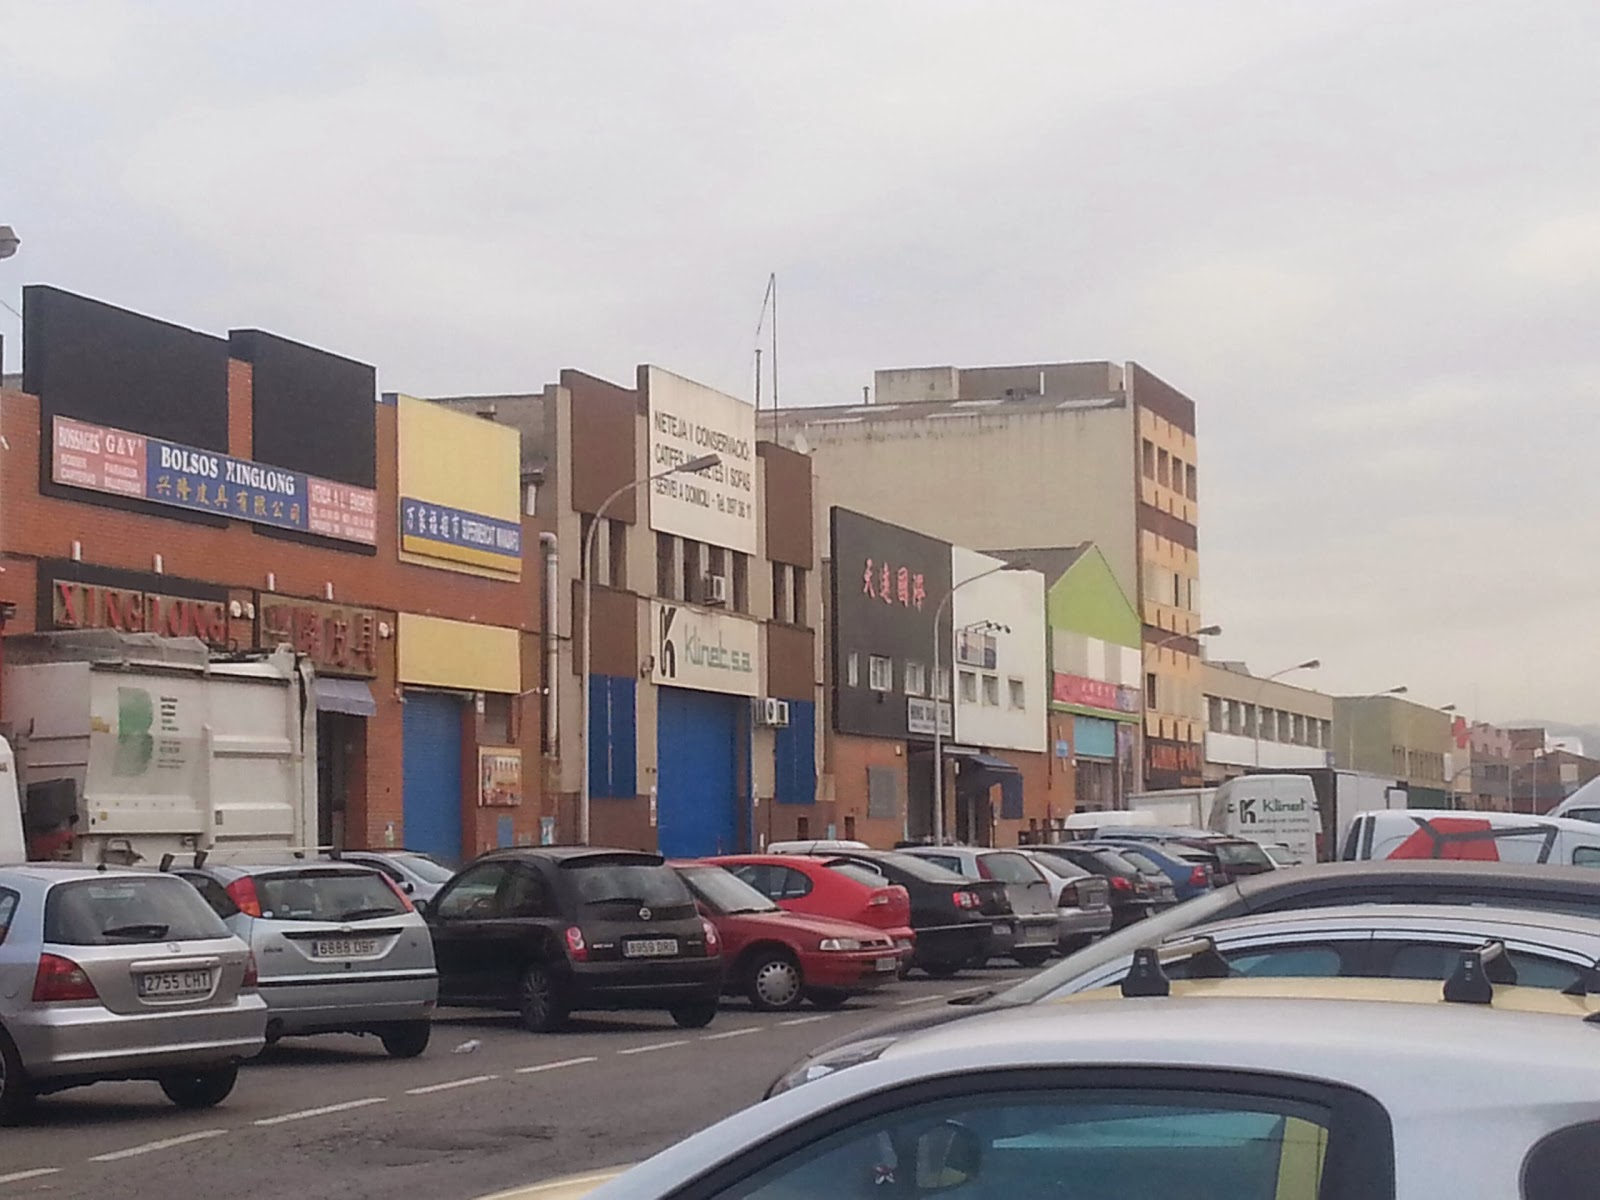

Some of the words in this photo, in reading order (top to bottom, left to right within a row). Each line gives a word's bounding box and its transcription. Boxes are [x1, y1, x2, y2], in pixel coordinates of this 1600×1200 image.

[654, 409, 688, 441] NETEJA
[161, 446, 218, 478] BOLSOS
[225, 460, 295, 495] XINGLONG
[146, 974, 181, 992] 2755
[184, 970, 210, 989] CHT
